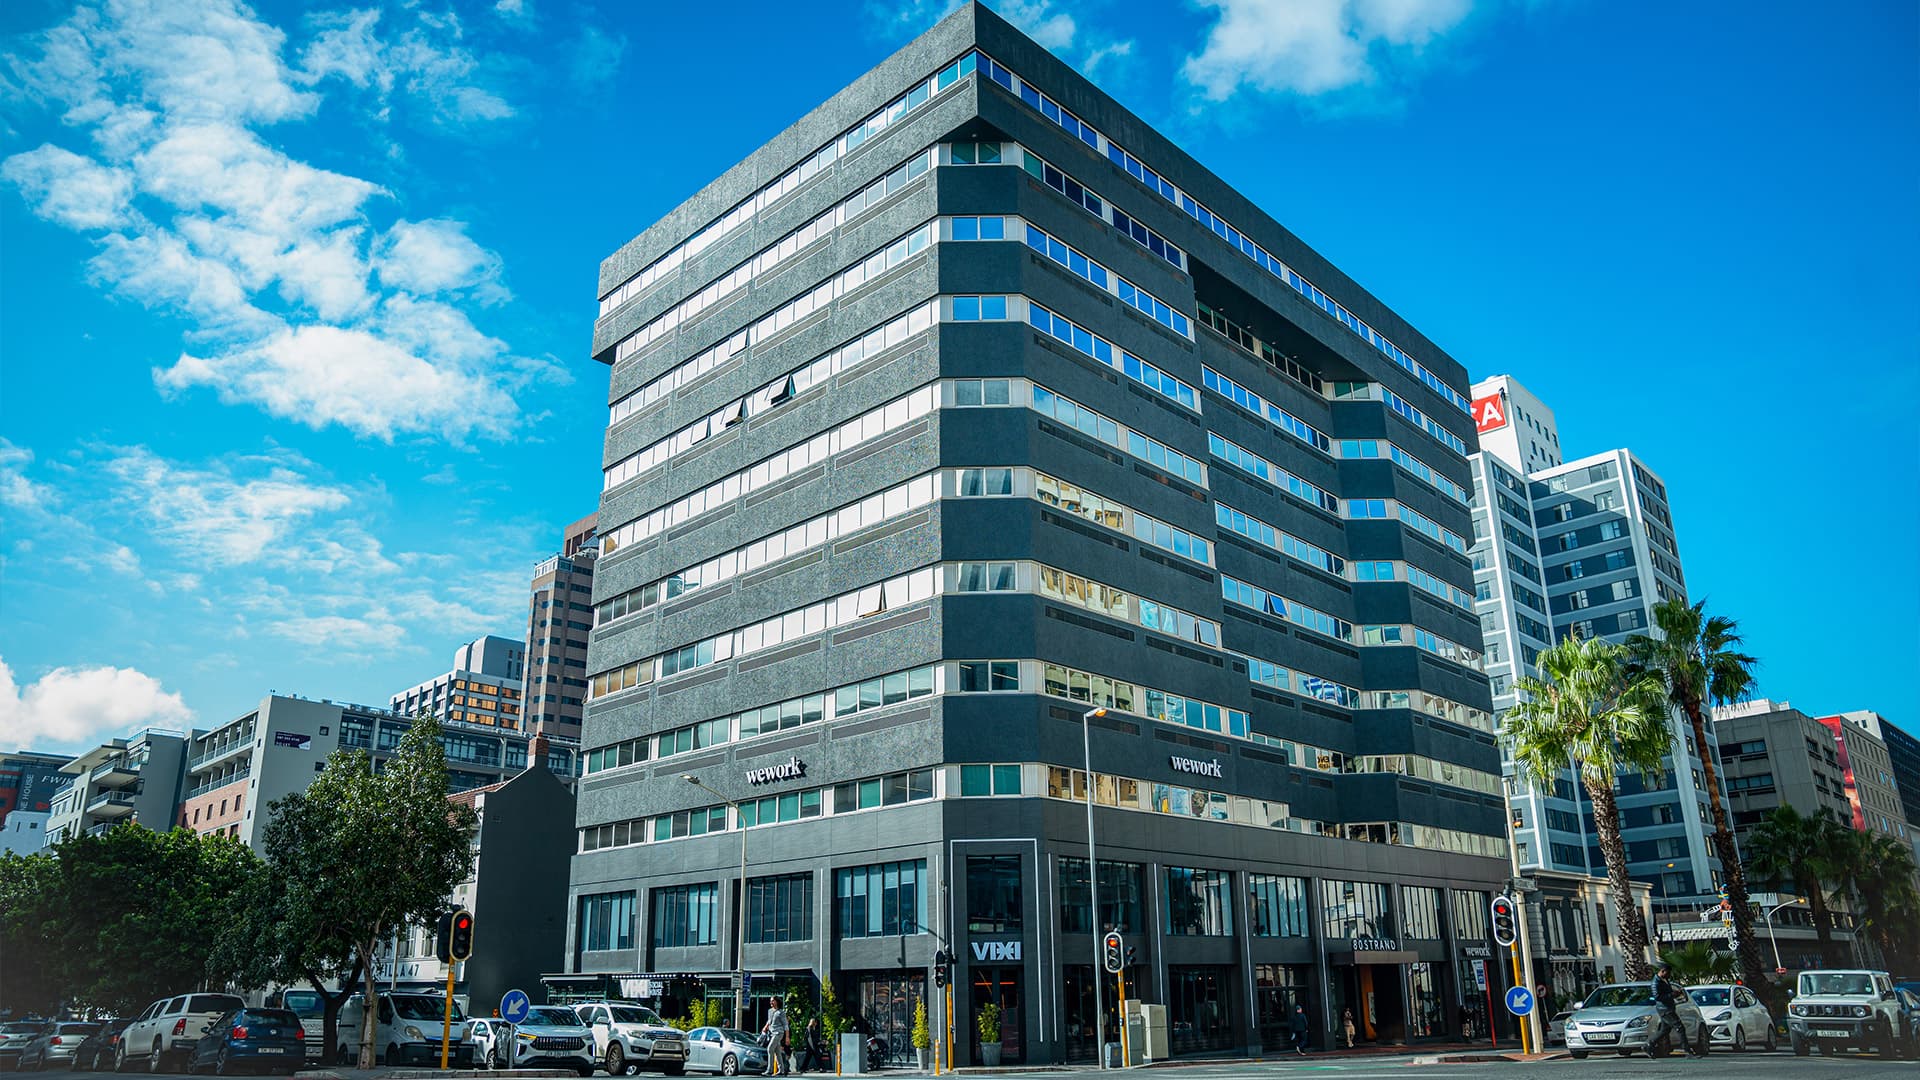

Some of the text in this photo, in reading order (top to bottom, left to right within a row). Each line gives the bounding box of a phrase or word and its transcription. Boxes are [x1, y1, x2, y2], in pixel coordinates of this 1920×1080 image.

[746, 756, 802, 784] wework
[1171, 756, 1222, 778] wework
[971, 941, 1022, 961] VIXI
[1465, 942, 1491, 957] wework
